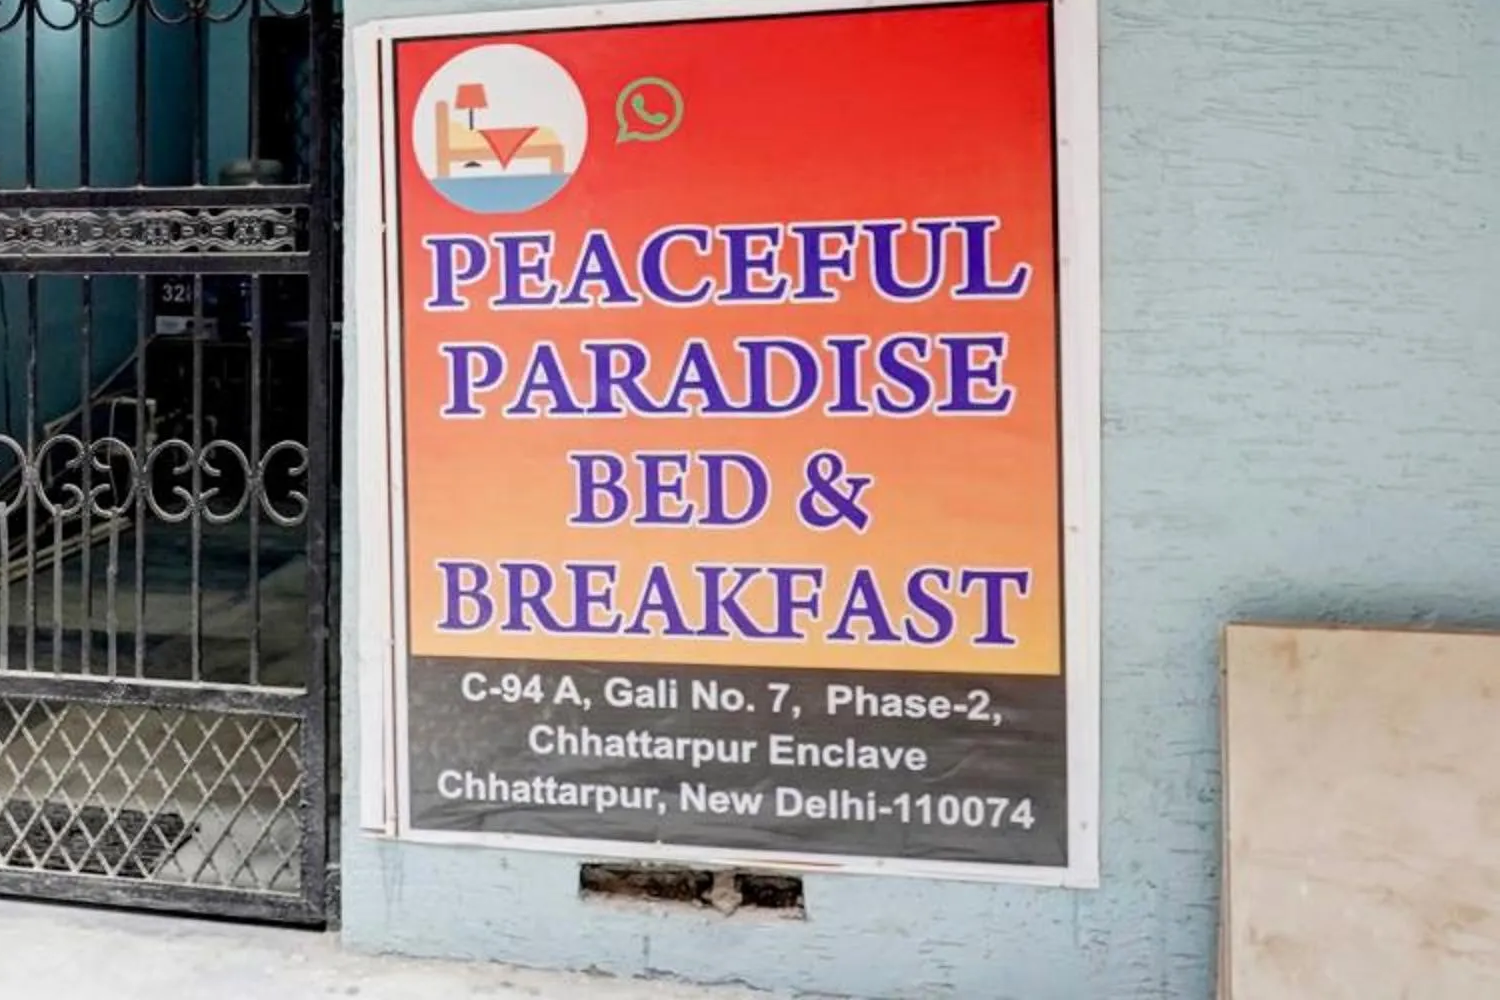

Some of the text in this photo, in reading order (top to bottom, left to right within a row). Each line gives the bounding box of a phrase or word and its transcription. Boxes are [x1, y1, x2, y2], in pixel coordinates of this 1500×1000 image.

[424, 216, 1031, 311] PEACEFUL
[440, 334, 1015, 418] PARADISE
[568, 452, 870, 532] BED &
[436, 559, 1031, 648] BREAKFAST
[461, 672, 1002, 726] C-94 A, Gali No. 7, Phase-2,
[528, 724, 928, 771] Chhattarpur Enclave
[437, 769, 1036, 830] Chhattarpur, New Delhi-110074
